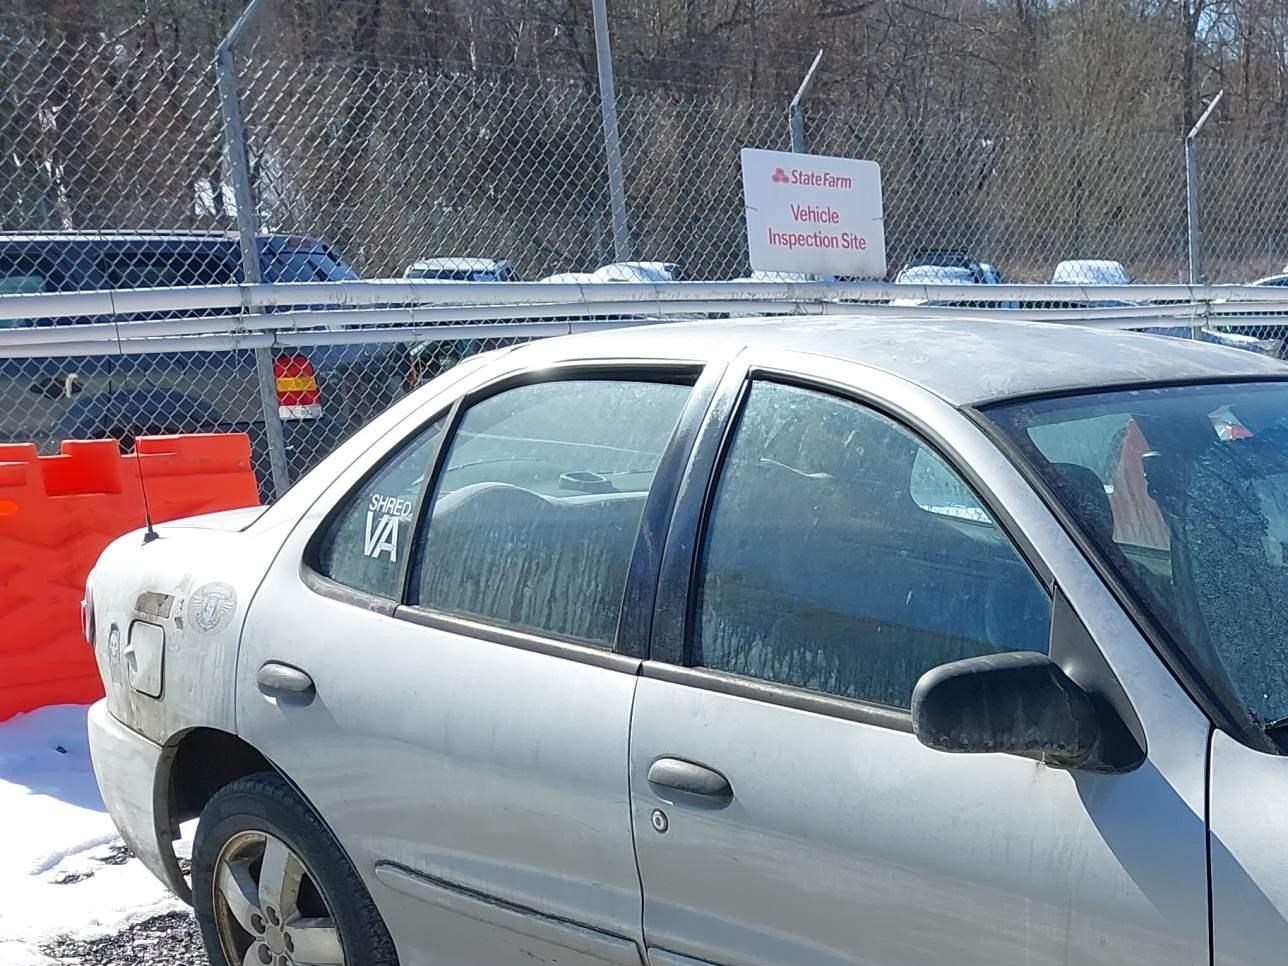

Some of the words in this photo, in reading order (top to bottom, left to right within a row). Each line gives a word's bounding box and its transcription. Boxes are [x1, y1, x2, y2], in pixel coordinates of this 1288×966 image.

[790, 204, 839, 224] Vehicle
[768, 228, 839, 249] Inspection
[841, 232, 866, 250] Site
[369, 494, 412, 517] SHRED
[364, 511, 399, 562] VA
